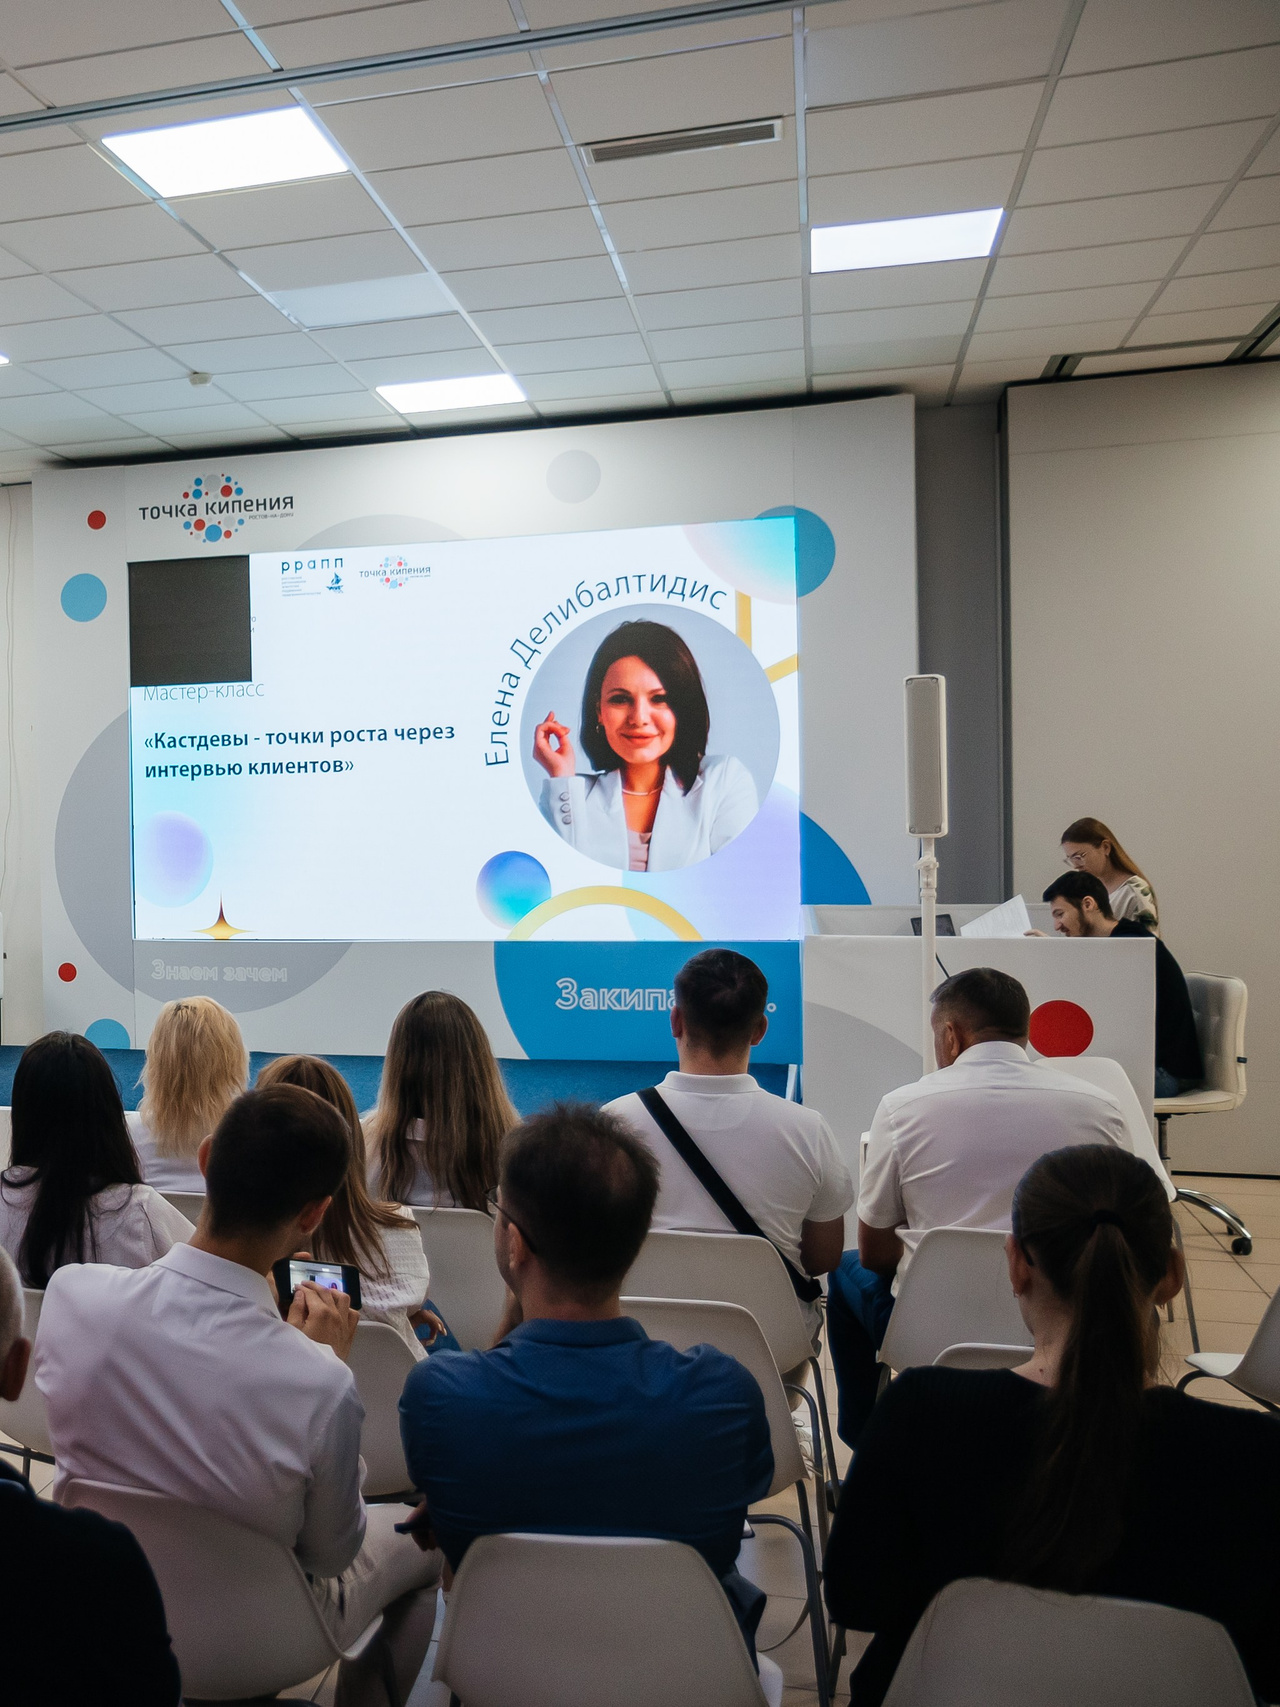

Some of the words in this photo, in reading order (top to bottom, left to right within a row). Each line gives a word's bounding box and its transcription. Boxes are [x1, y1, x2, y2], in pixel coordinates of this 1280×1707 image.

[139, 503, 198, 521] точка
[205, 496, 294, 515] кипения
[358, 568, 387, 578] точка
[389, 566, 431, 576] кипения
[484, 672, 521, 767] Елена
[510, 573, 727, 670] Делибалтидис
[143, 681, 265, 704] Мастер-класс
[144, 732, 249, 751] «Кастдевы
[265, 729, 324, 746] точки
[330, 728, 388, 748] роста
[394, 725, 456, 745] через
[145, 760, 243, 782] интервью
[248, 758, 355, 776] клиентов»
[151, 958, 218, 982] Знаем
[223, 966, 288, 983] зачем
